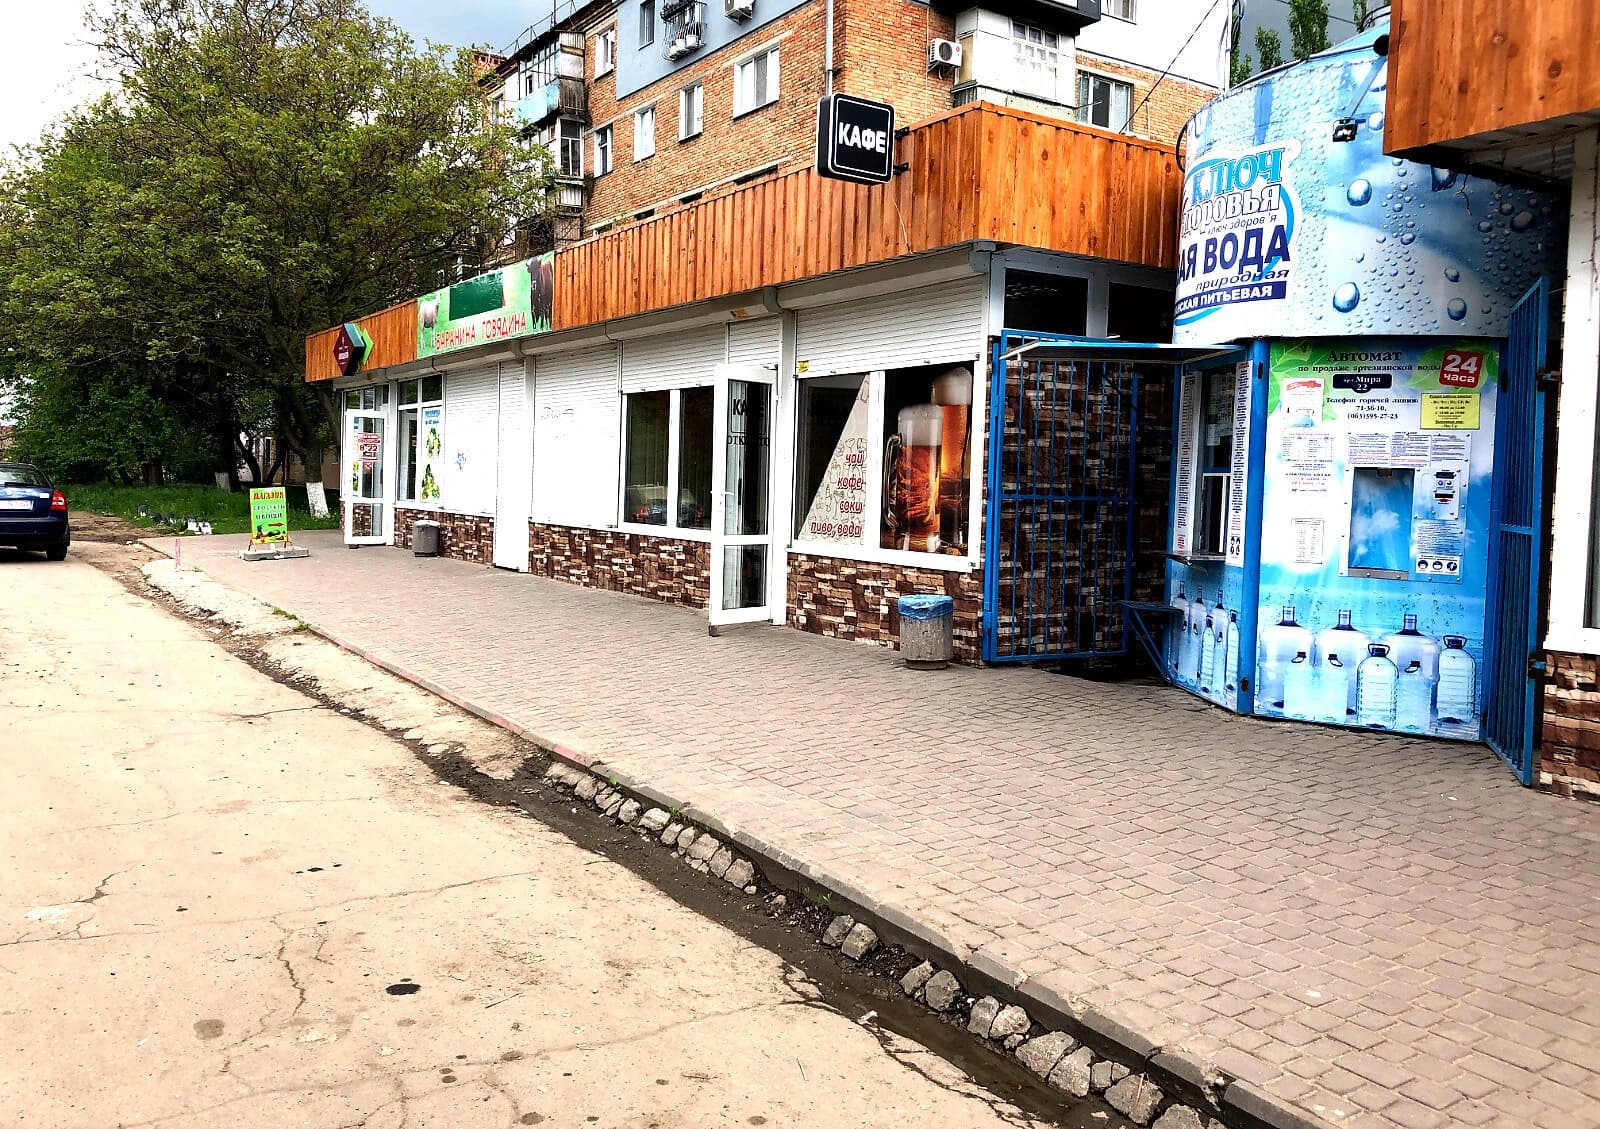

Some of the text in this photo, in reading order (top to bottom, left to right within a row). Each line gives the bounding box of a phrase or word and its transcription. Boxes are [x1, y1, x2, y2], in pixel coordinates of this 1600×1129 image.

[838, 122, 887, 153] КАФЕ
[1203, 224, 1290, 275] ВОДА
[1196, 269, 1290, 291] природная
[1200, 285, 1273, 305] ПИТЬЕВАЯ
[435, 311, 527, 351] БАРАНИНА ГОВЯДИНА
[1327, 350, 1403, 362] Автомат
[1443, 354, 1478, 374] 24
[1313, 365, 1349, 374] продаже
[1353, 364, 1413, 373] артезианской
[1355, 376, 1381, 385] Мира
[1443, 372, 1475, 383] часа
[1356, 383, 1368, 391] 22
[1326, 397, 1356, 405] Телефон
[1359, 397, 1390, 405] горячей
[845, 449, 864, 465] чай
[837, 474, 863, 490] кофе
[839, 500, 863, 513] соки
[256, 512, 282, 520] ОВОЩИ
[811, 520, 862, 537] пиво, вода
